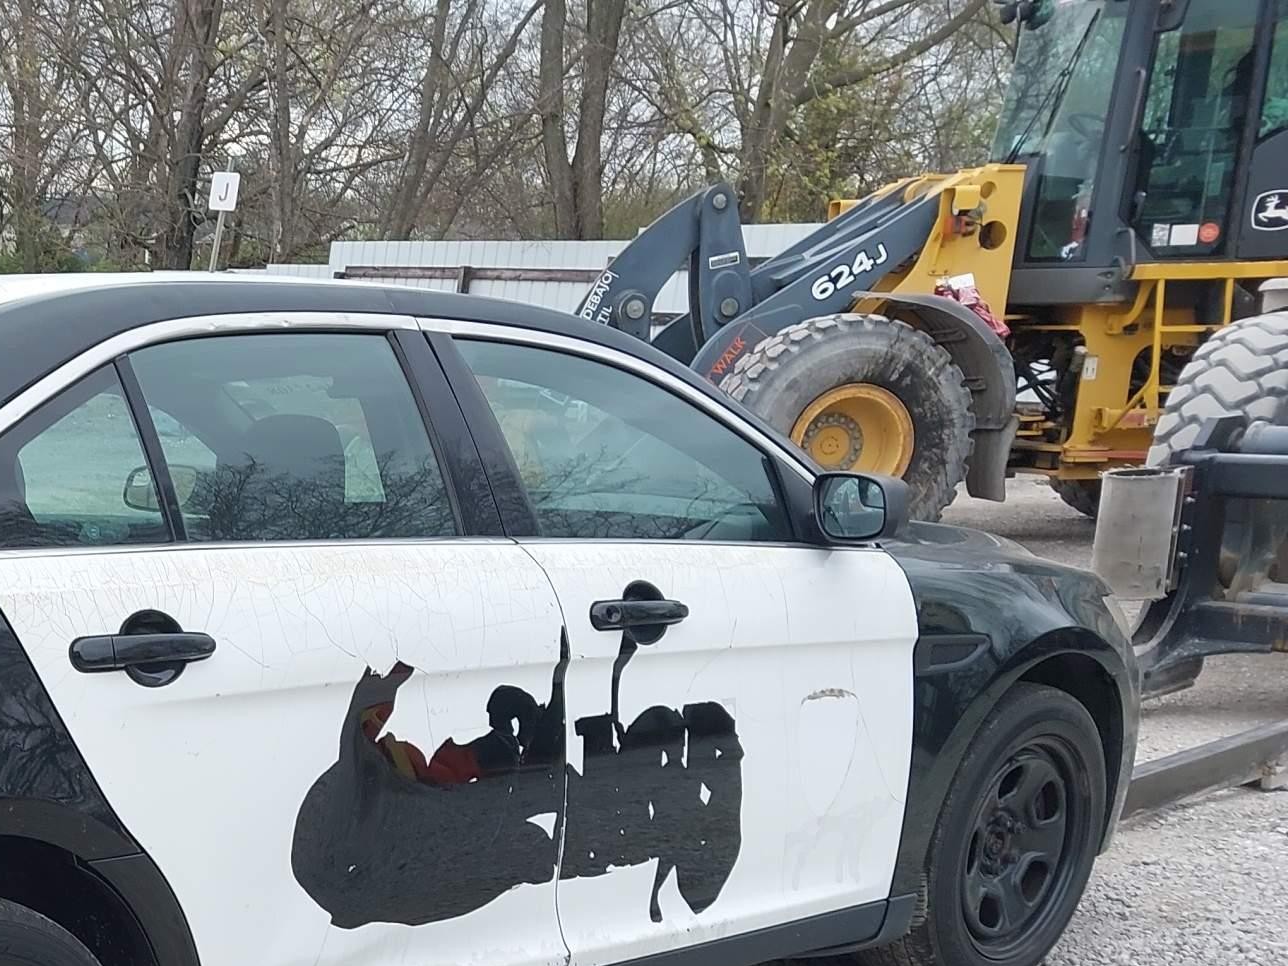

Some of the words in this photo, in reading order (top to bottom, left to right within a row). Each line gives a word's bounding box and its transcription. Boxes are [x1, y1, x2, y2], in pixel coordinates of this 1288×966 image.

[218, 182, 230, 202] J
[811, 243, 888, 300] 624J
[583, 273, 613, 320] DEBAJO
[711, 336, 745, 375] WALK
